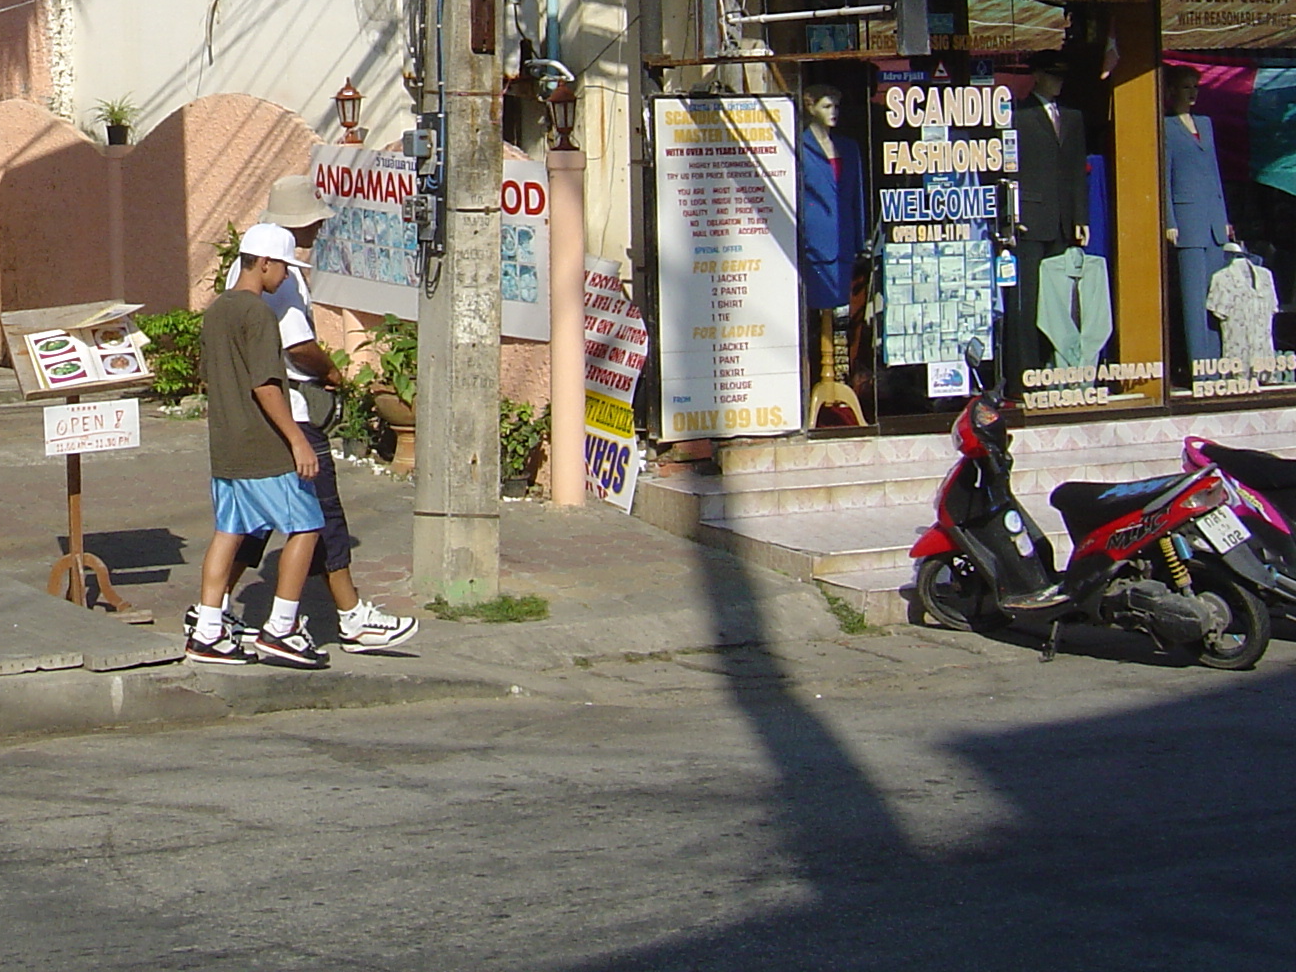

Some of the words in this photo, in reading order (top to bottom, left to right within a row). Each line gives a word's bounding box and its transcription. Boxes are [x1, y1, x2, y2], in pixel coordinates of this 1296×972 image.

[1177, 11, 1202, 26] WITH
[885, 85, 1013, 128] SCANDIC
[674, 128, 723, 143] MASTER
[883, 138, 1002, 175] FASHIONS
[315, 163, 416, 206] ANDAMAN
[879, 184, 997, 222] WELCOME
[892, 225, 917, 243] OPEN
[692, 261, 717, 275] FOR
[720, 259, 762, 273] GENTS
[717, 274, 748, 283] JACKET
[718, 312, 731, 322] TIE
[692, 326, 717, 340] FOR
[720, 324, 766, 338] LADIES
[718, 342, 750, 352] JACKET
[719, 355, 741, 365] PANT
[1193, 357, 1242, 377] HUGO
[1022, 366, 1095, 389] GIORGIO
[1098, 361, 1164, 382] ARMANI
[1192, 378, 1261, 398] ESCADA
[1022, 387, 1109, 410] VERSACE
[56, 414, 105, 436] OPEN
[672, 408, 720, 433] ONLY
[724, 407, 752, 430] 99
[1222, 529, 1244, 548] 102
